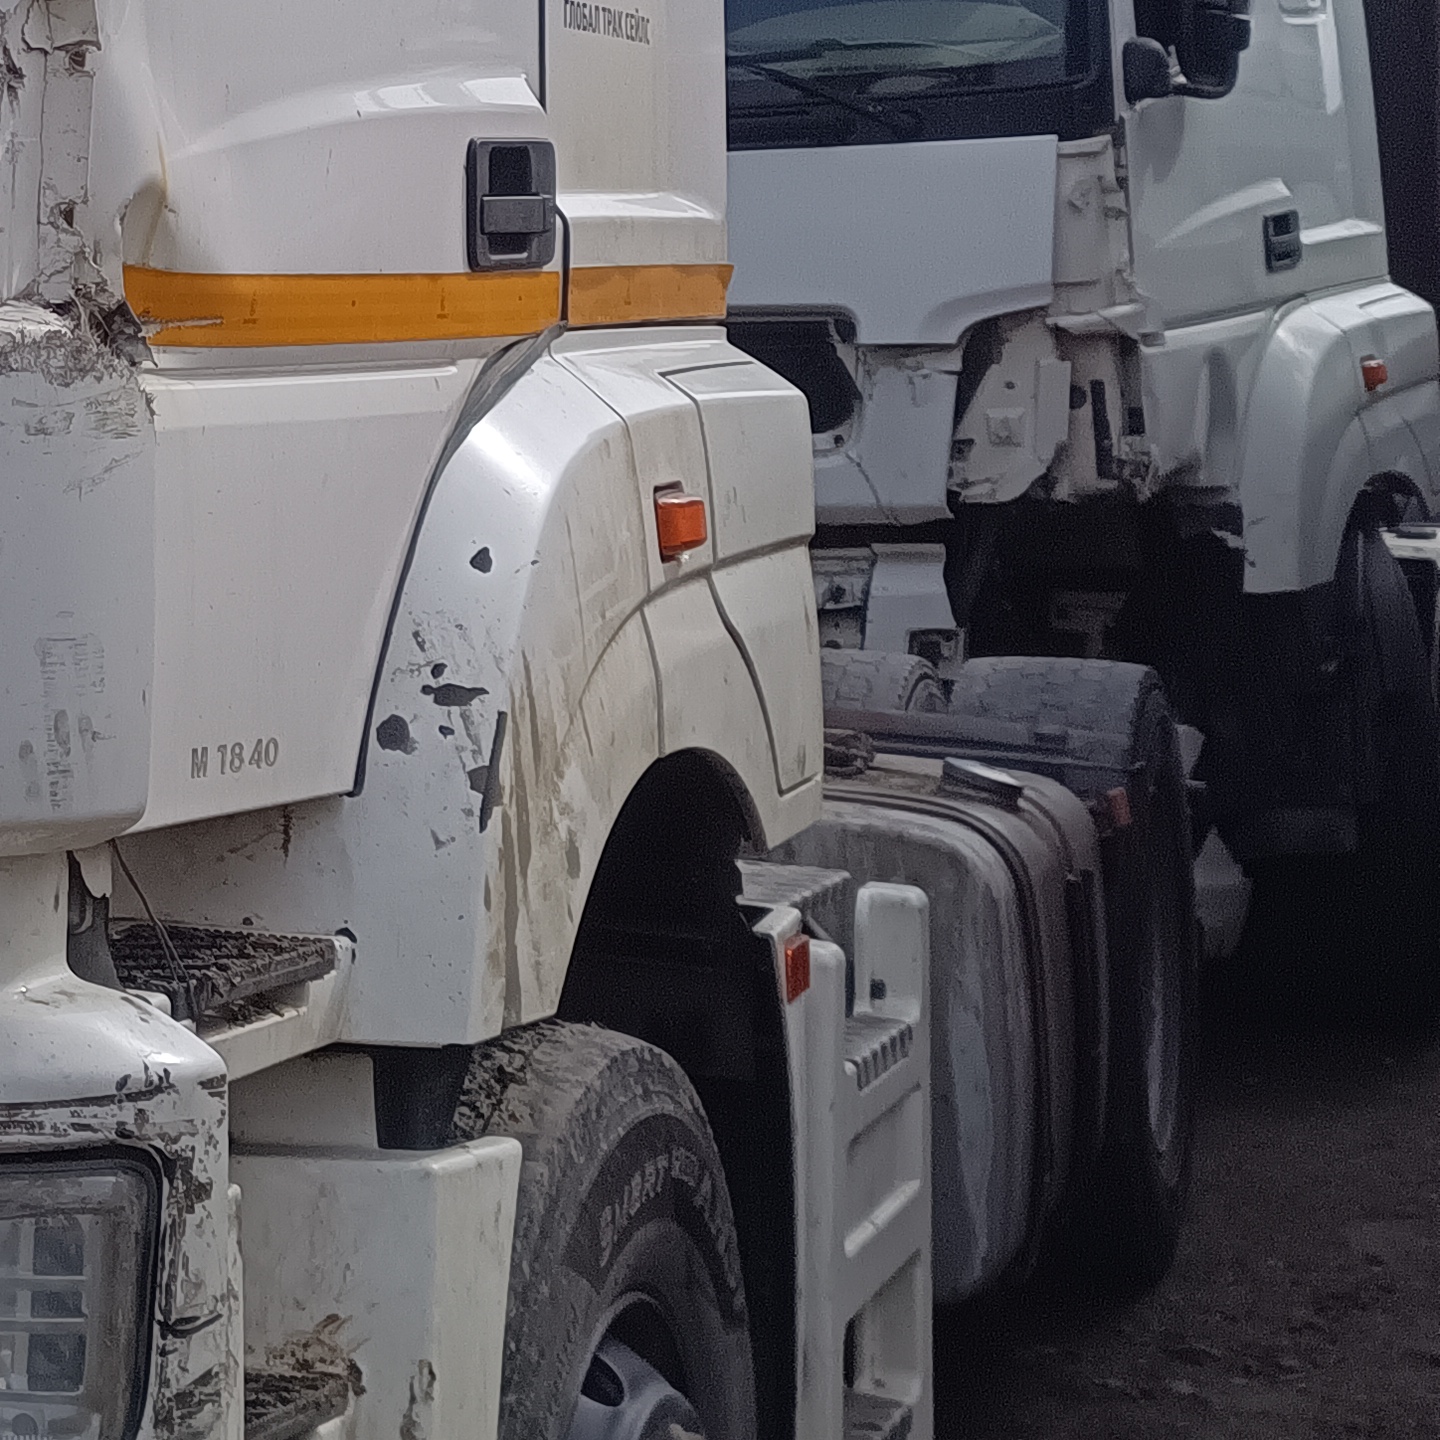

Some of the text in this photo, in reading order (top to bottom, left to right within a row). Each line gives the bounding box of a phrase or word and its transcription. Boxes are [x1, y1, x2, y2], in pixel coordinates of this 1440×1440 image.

[600, 6, 625, 40] ТРАК
[191, 737, 279, 779] M 1840
